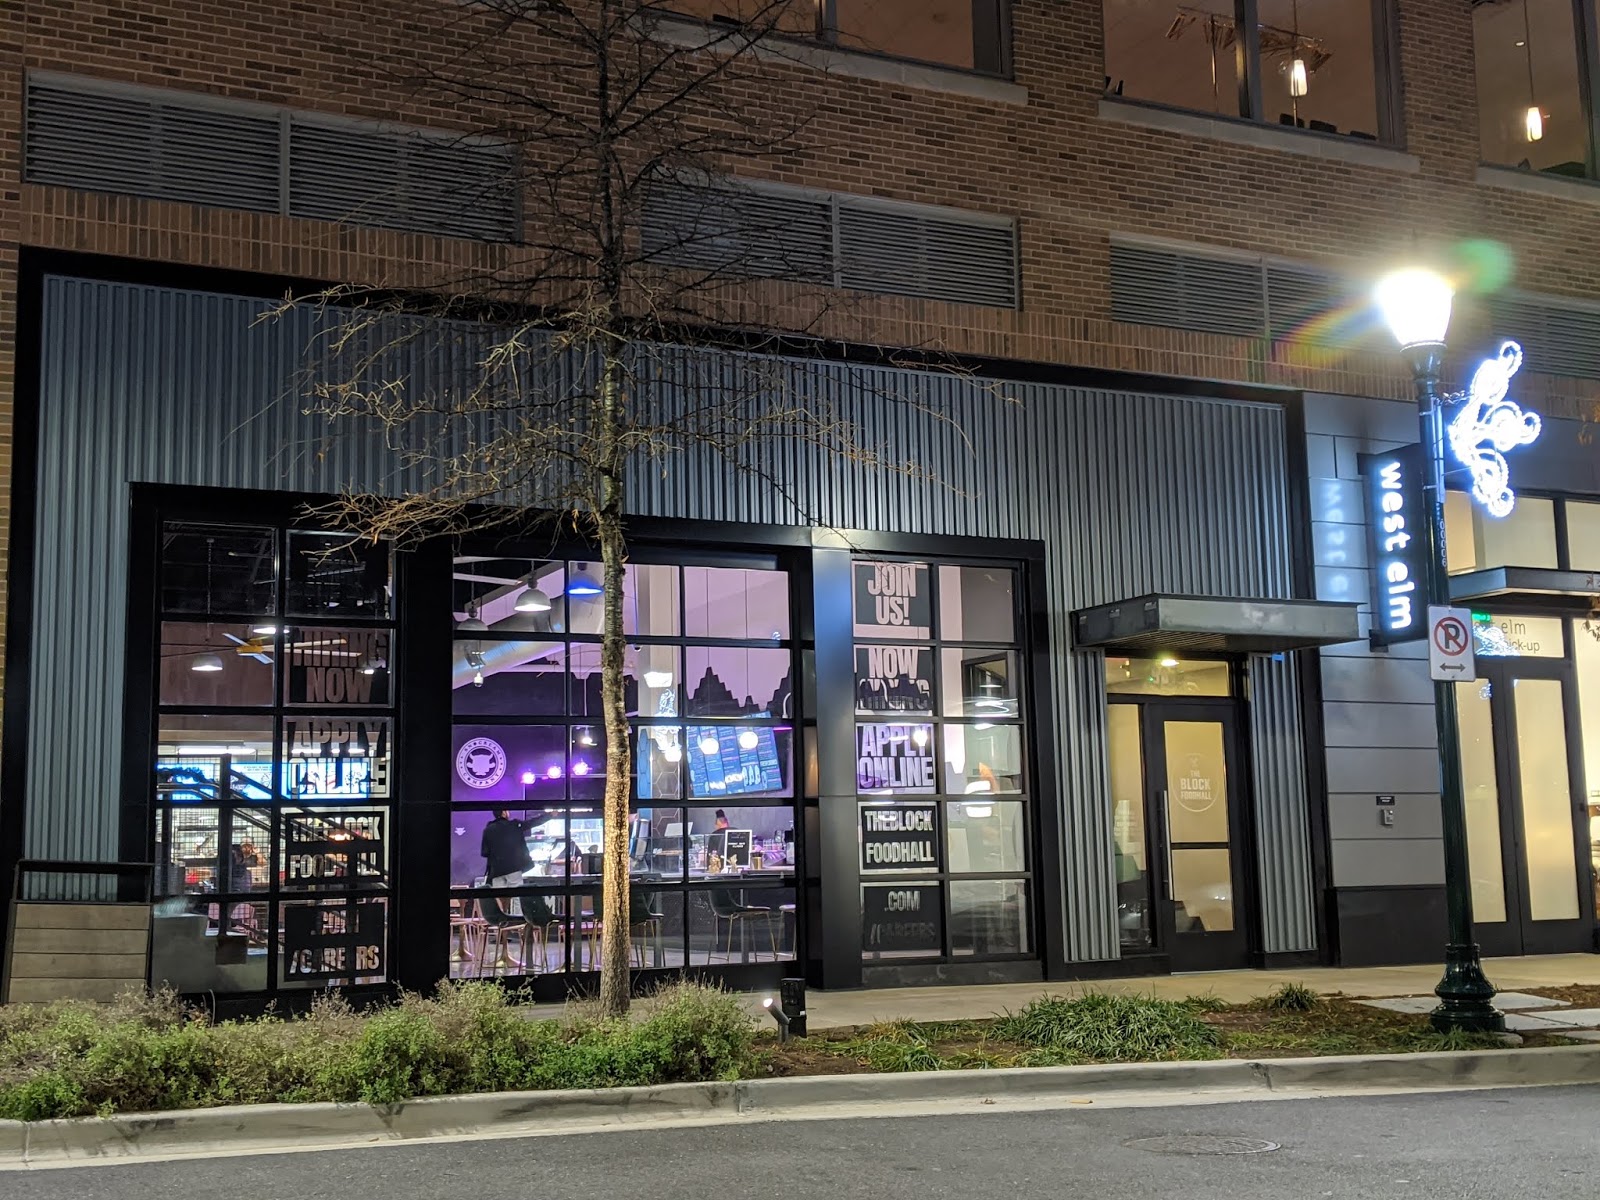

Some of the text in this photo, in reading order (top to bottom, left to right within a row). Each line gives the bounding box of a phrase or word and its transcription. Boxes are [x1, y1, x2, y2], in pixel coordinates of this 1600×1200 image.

[1380, 462, 1415, 629] west elm
[867, 564, 917, 597] JOIN
[875, 595, 911, 626] US!
[1501, 619, 1526, 635] elm
[868, 648, 919, 679] NOW
[306, 668, 372, 703] NOW
[291, 722, 383, 758] APPLY
[861, 726, 933, 757] APPLY
[859, 756, 934, 788] ONLINE
[1180, 778, 1211, 791] BLOCK
[864, 810, 934, 832] THEBLOCK
[865, 840, 935, 863] FOODHALL
[884, 890, 921, 912] .COM
